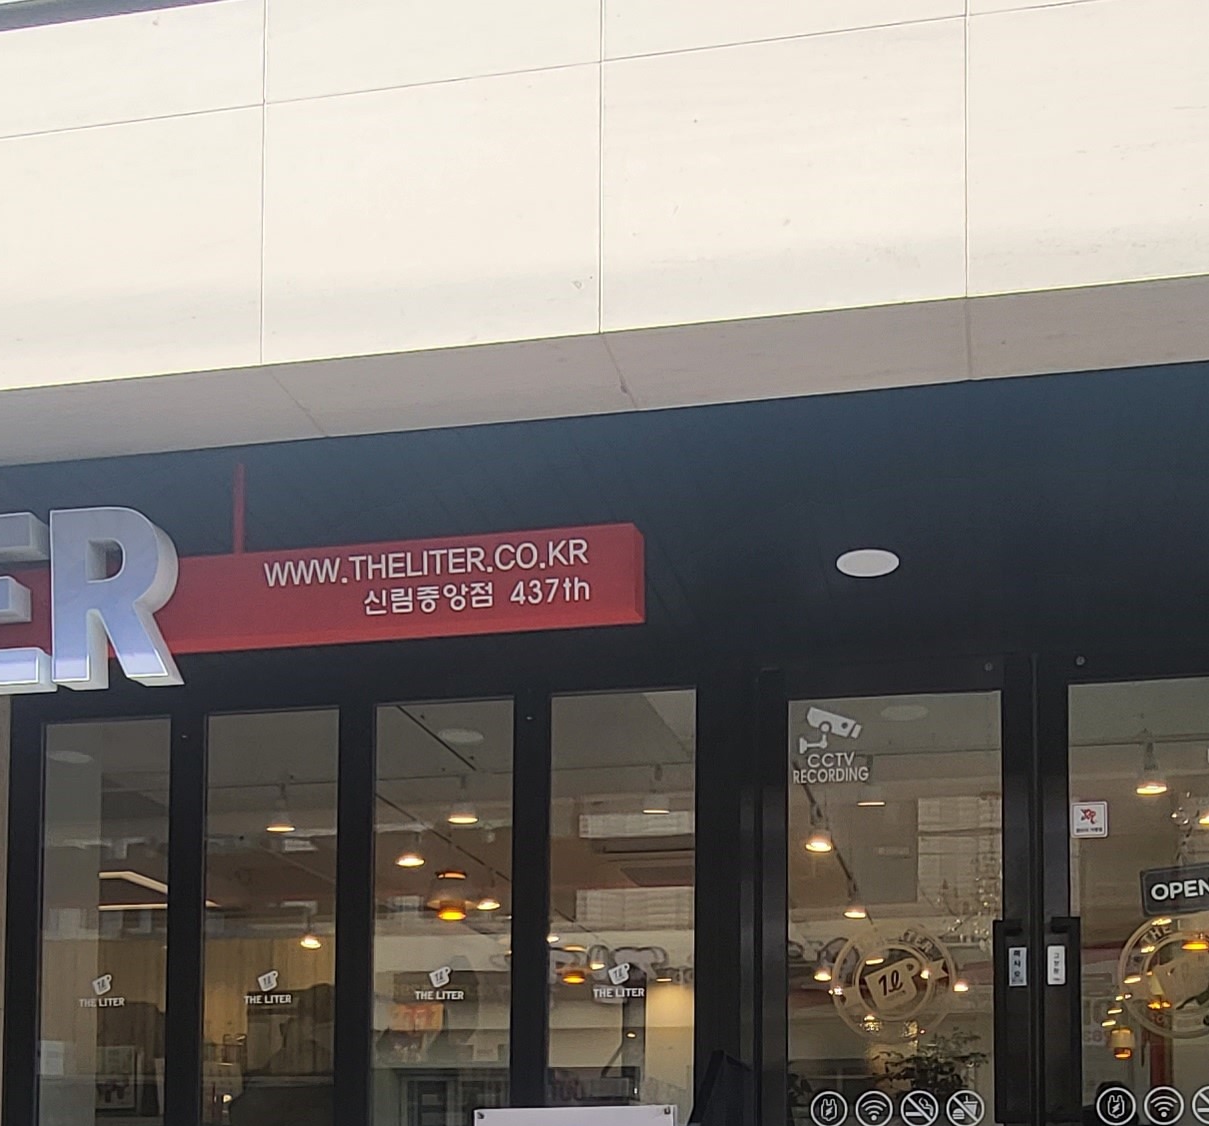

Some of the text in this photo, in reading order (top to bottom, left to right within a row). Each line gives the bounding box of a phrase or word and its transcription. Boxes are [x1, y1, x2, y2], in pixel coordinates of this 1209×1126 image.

[263, 538, 589, 588] WWW.THELITER.CO.KR
[363, 576, 591, 616] 신림중앙점 437th
[807, 751, 855, 768] CCTV
[793, 766, 870, 784] RECORDING
[1150, 879, 1209, 901] OPEN
[244, 994, 291, 1004] THE LITER
[415, 990, 464, 1000] THE LITER
[593, 987, 645, 999] THE LITER
[79, 997, 125, 1008] THE LITER
